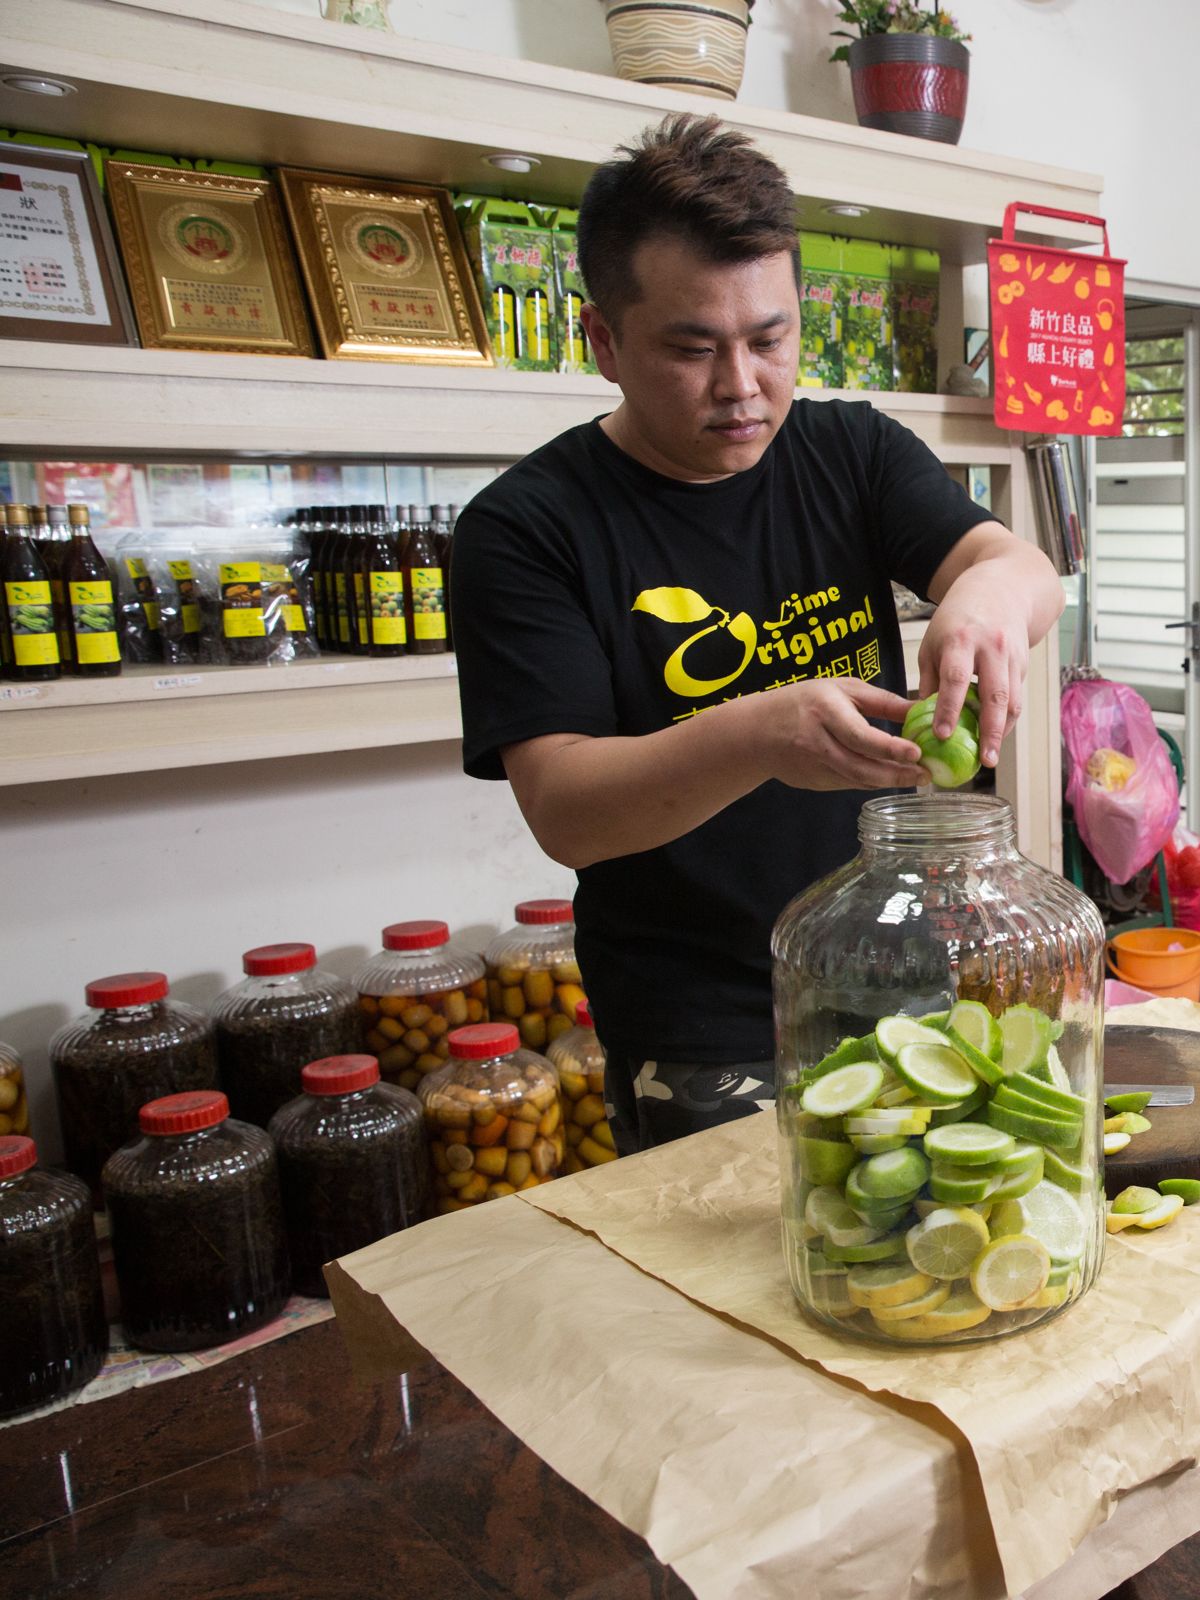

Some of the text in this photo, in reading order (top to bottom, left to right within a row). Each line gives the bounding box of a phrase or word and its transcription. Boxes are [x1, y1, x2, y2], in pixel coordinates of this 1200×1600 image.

[1028, 307, 1094, 336] 新竹良品
[1027, 342, 1095, 369] 縣上好禮
[763, 586, 841, 630] Lime
